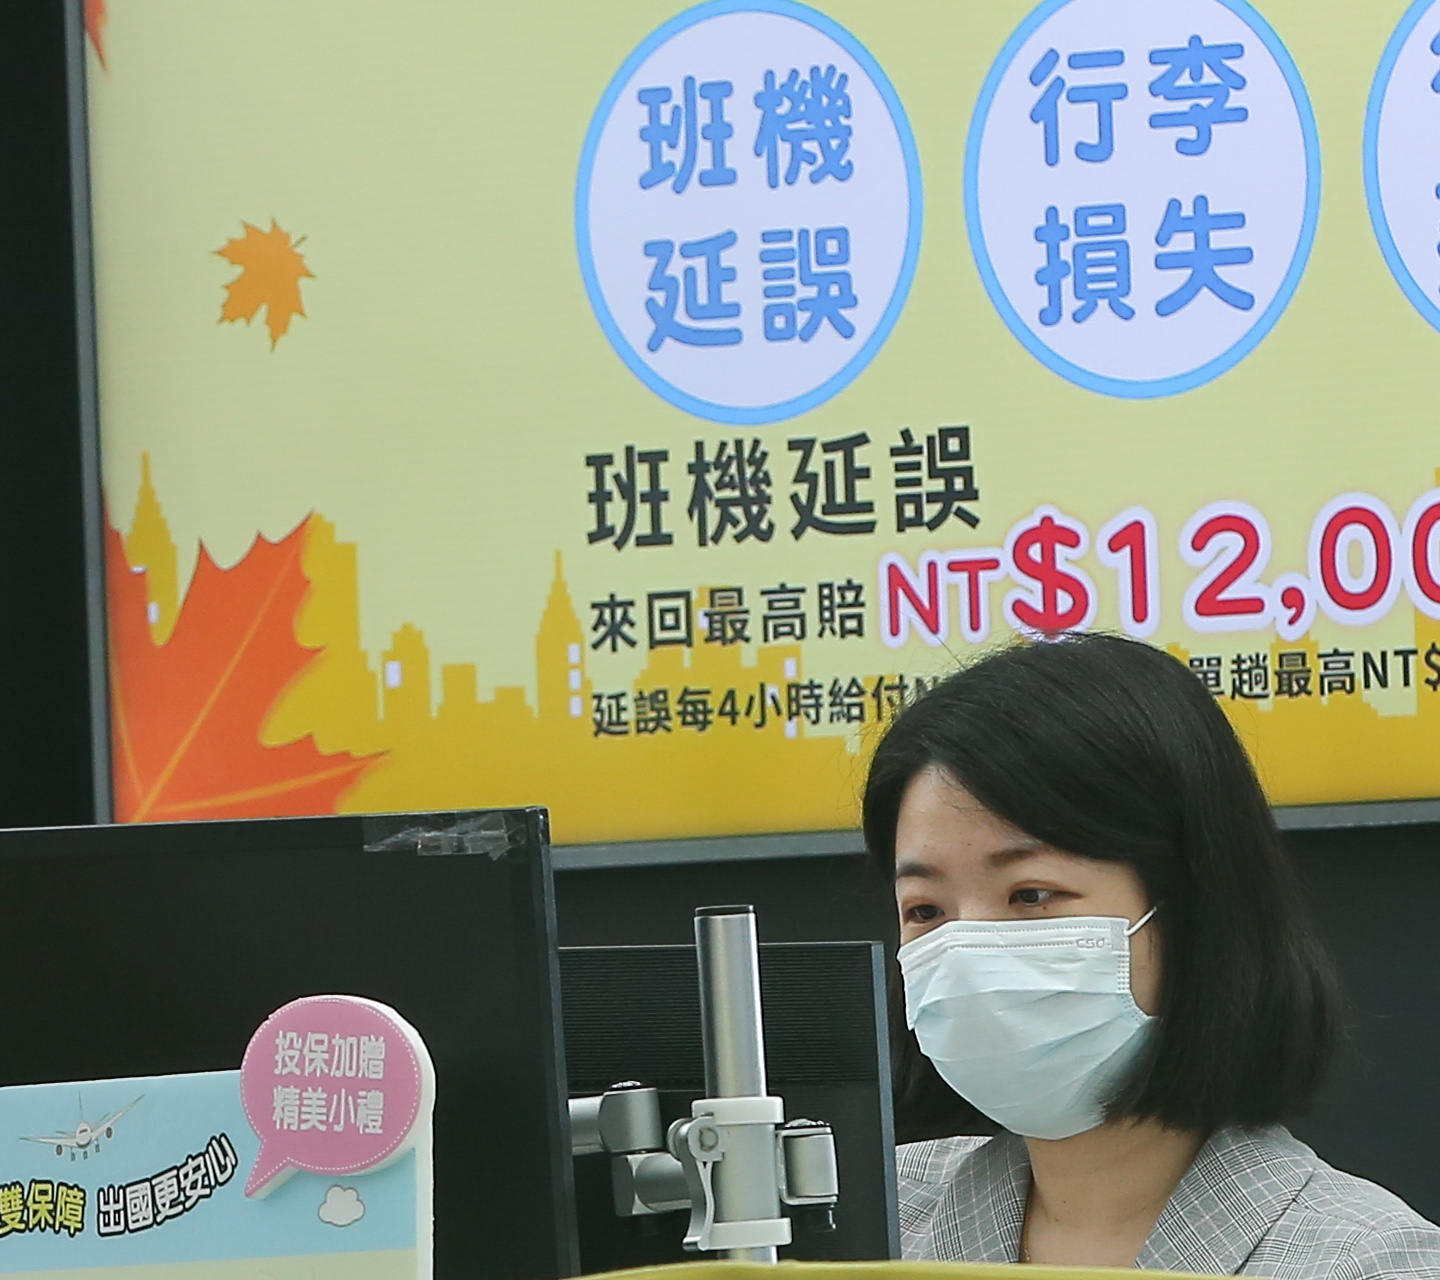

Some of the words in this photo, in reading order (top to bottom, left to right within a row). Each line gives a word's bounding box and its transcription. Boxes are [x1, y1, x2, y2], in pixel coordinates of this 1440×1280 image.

[636, 63, 856, 196] 班機
[1028, 33, 1251, 166] 行李
[641, 226, 862, 353] 延誤
[1030, 196, 1258, 327] 損失
[583, 424, 982, 554] 班機延誤
[590, 580, 866, 652] 來回最高賠
[273, 1030, 387, 1079] 投保加贈
[273, 1086, 386, 1135] 精美小禮
[96, 1133, 239, 1238] 出國更安心
